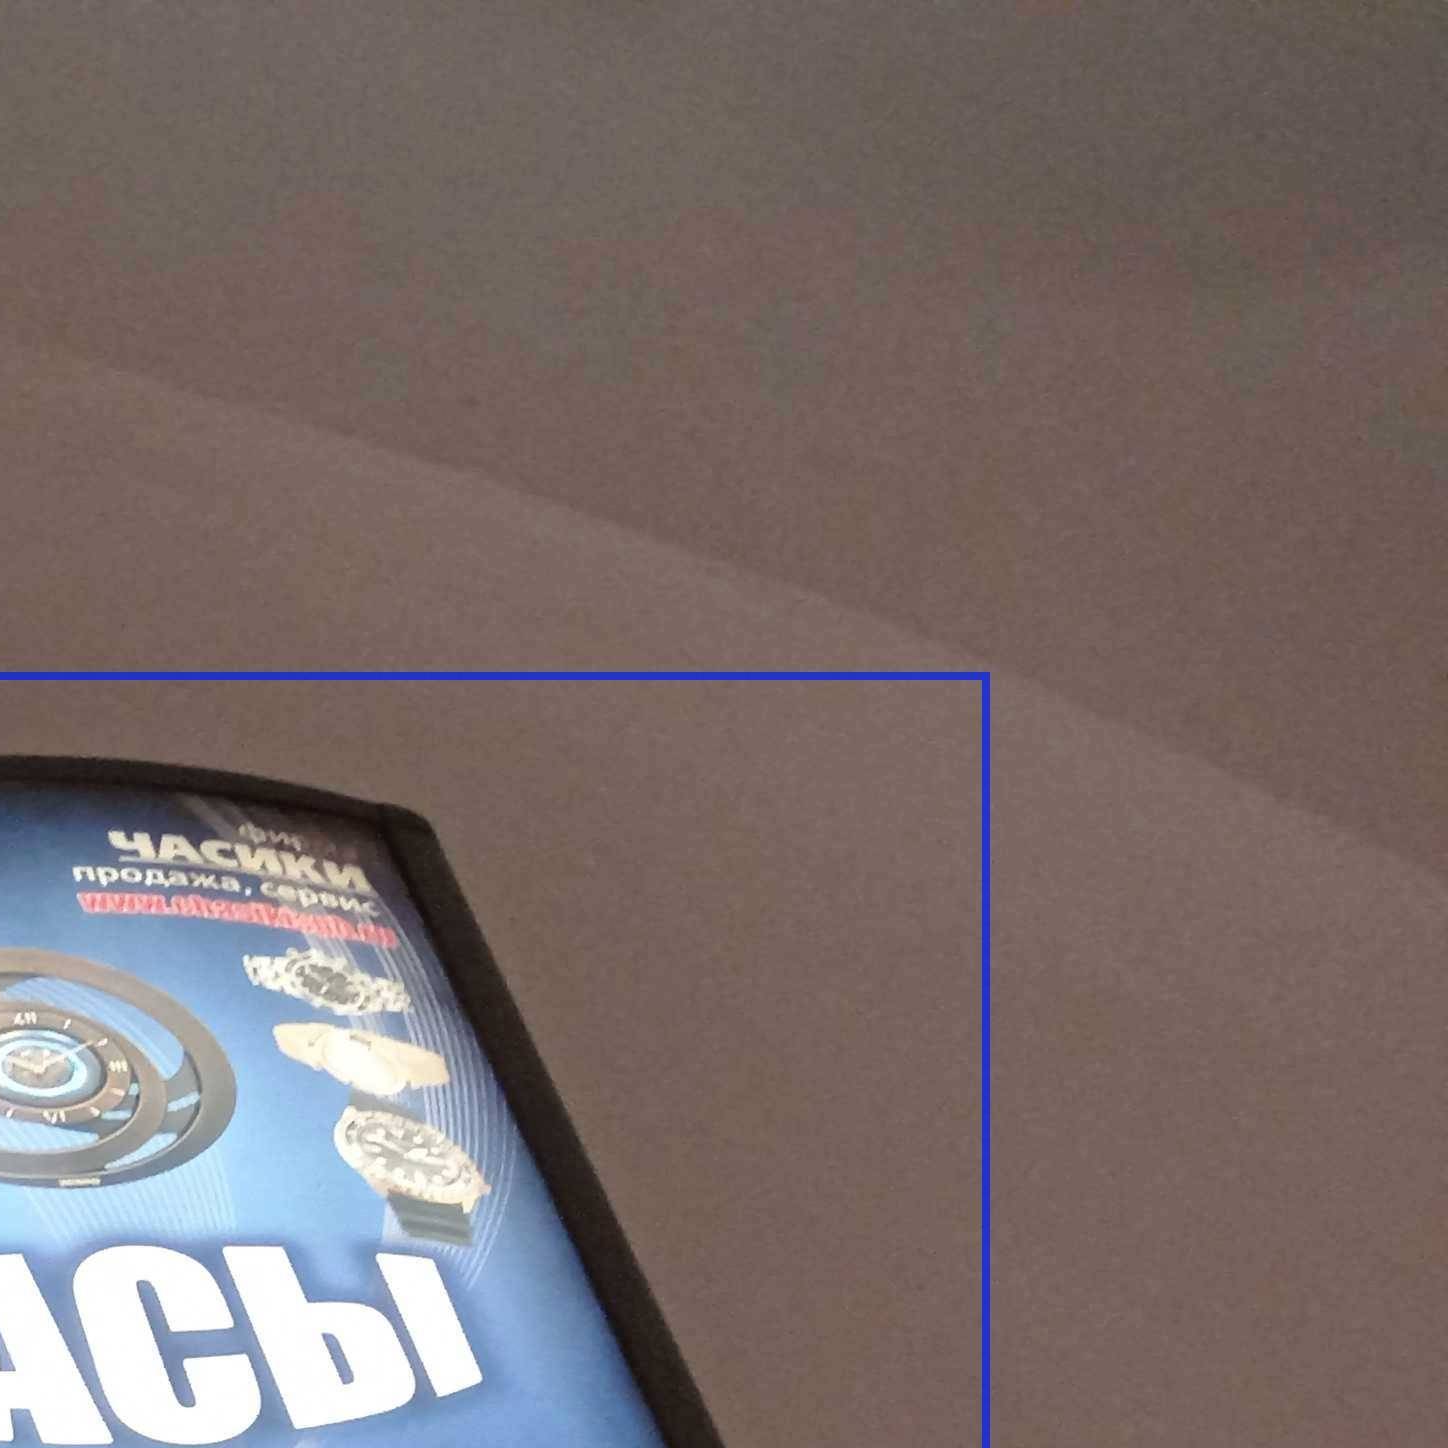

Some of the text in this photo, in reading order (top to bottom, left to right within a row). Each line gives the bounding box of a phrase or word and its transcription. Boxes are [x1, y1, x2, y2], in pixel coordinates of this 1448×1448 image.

[72, 864, 381, 918] продажа, сервис
[108, 829, 375, 895] ЧАСИКИ
